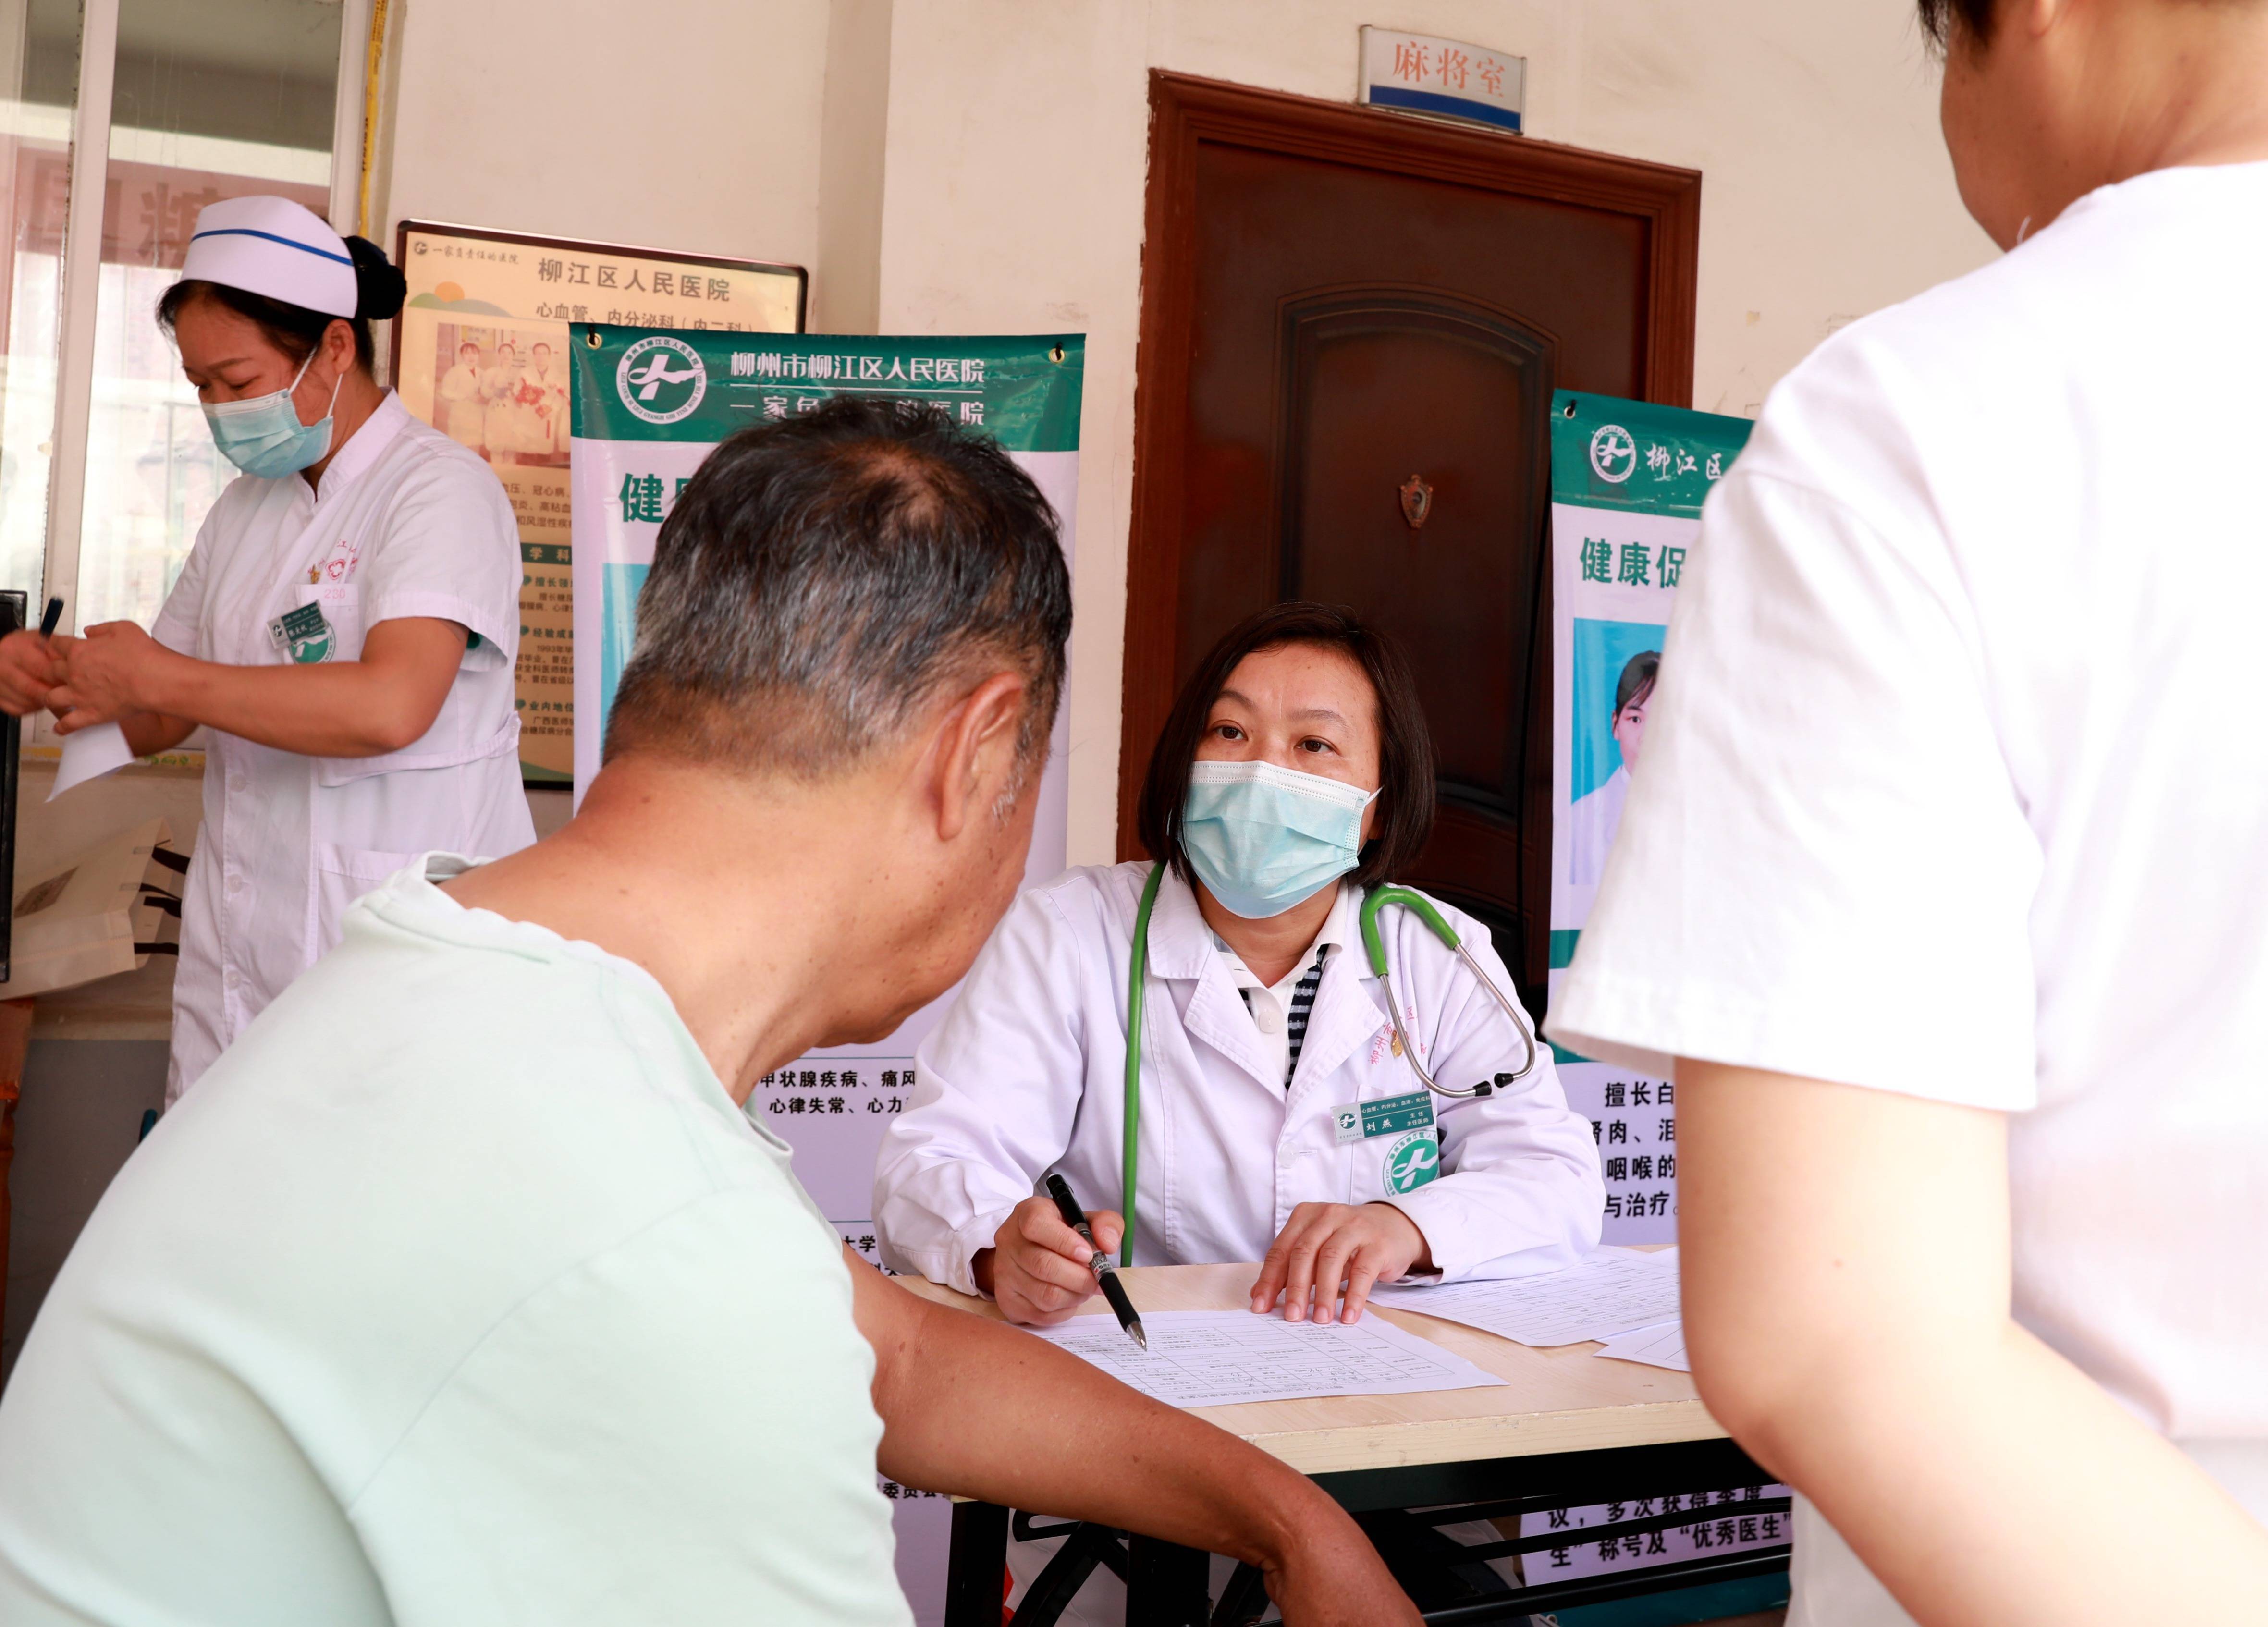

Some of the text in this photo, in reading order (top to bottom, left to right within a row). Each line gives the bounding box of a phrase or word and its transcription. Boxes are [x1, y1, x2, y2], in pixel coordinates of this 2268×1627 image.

[1393, 41, 1505, 98] 麻将室
[538, 257, 730, 302] 柳江区人民医院
[730, 351, 984, 383] 柳州市柳江区人民医院
[1645, 443, 1723, 480] 柳江区
[1580, 537, 1687, 589] 健康促
[770, 1097, 909, 1114] 心律失常、心力
[1605, 1081, 1674, 1107] 擅长白
[1366, 1118, 1392, 1131] 刘燕
[1407, 1117, 1429, 1126] 主任医师
[1606, 1154, 1676, 1182] 咽喉的
